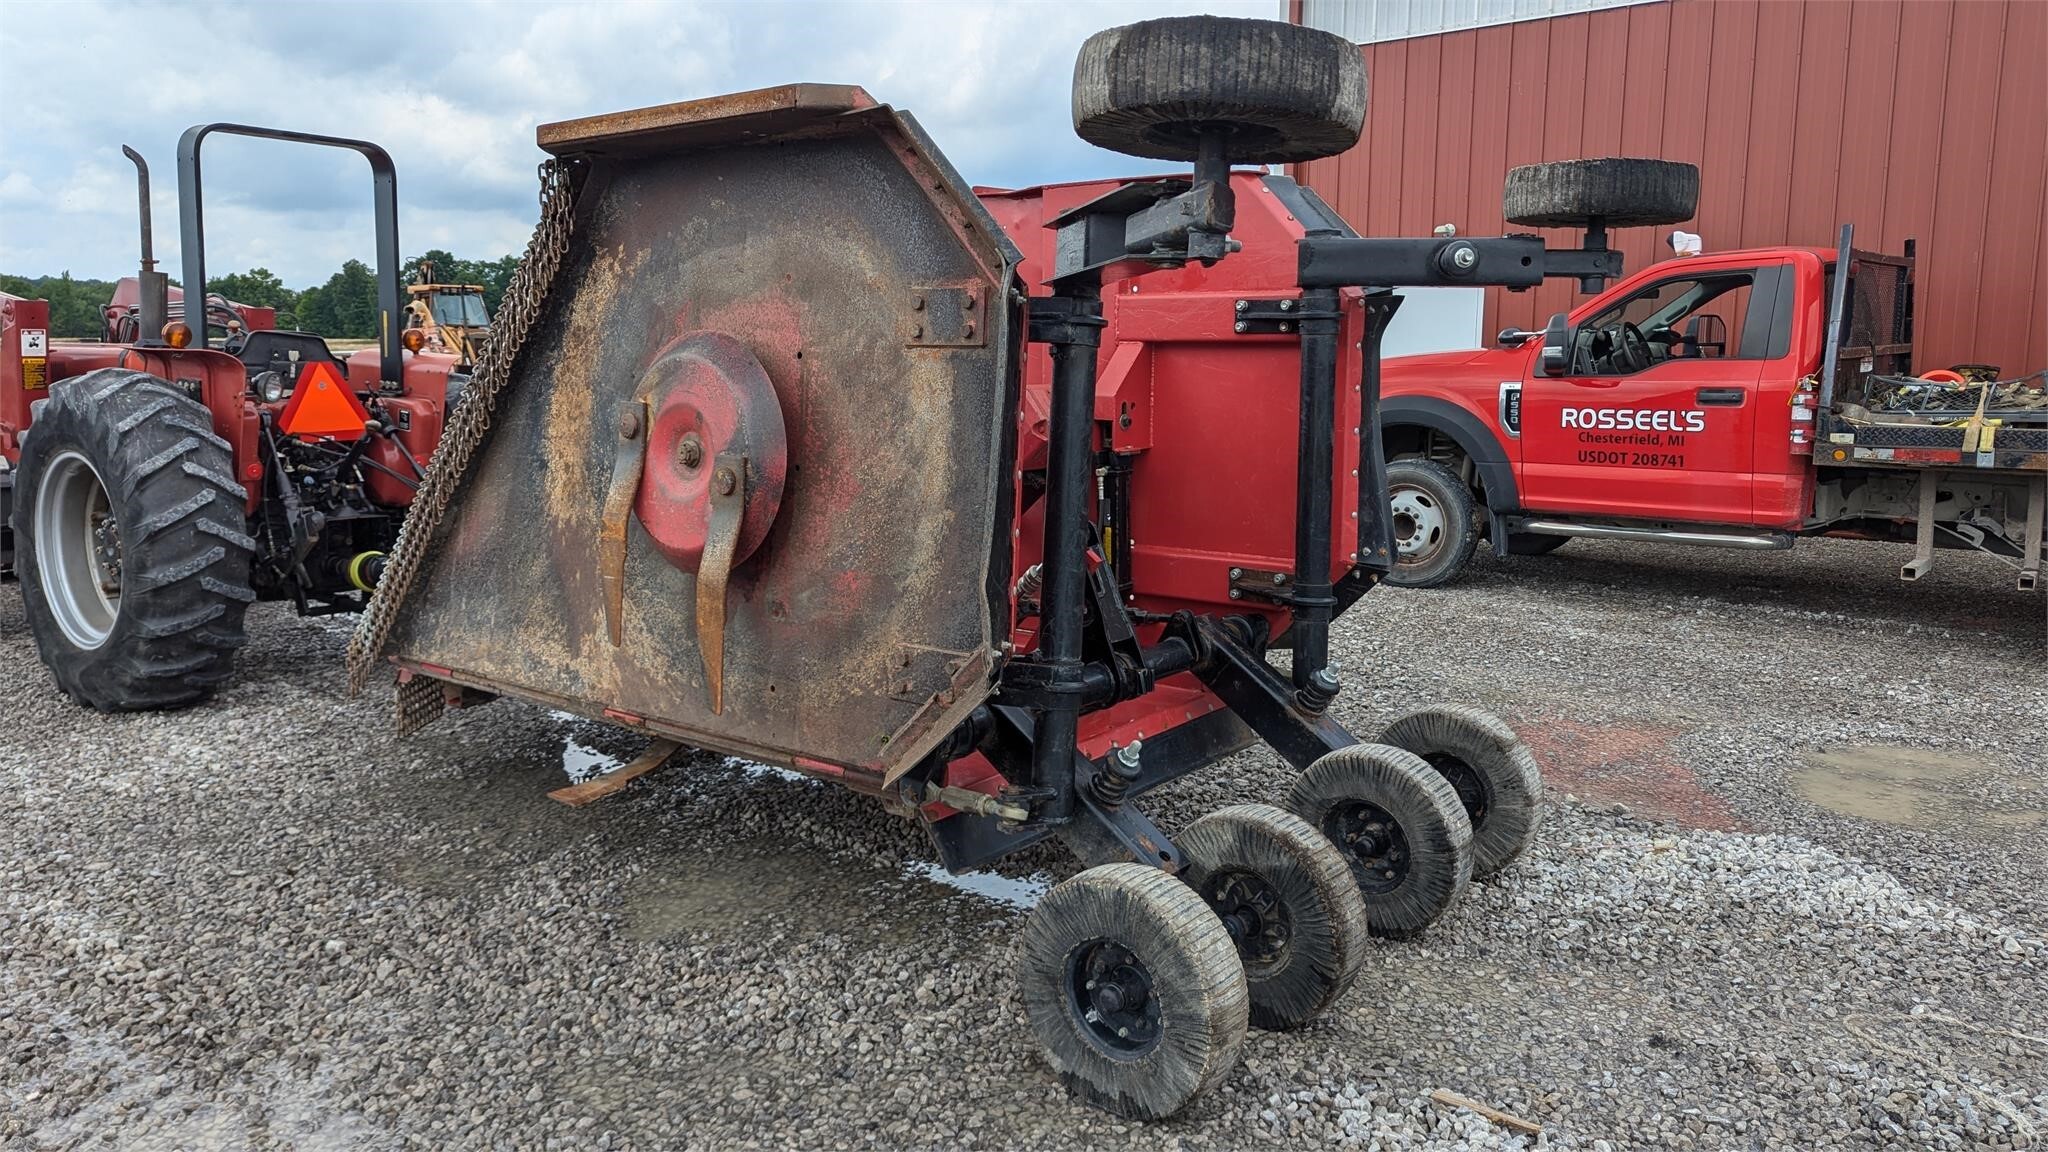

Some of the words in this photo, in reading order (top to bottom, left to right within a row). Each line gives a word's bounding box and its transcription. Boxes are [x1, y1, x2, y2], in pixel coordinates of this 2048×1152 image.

[1510, 393, 1520, 424] F550
[1561, 408, 1705, 432] ROSSEEL'S
[1578, 431, 1664, 447] Chesterfield,
[1667, 435, 1685, 446] MI
[1578, 450, 1628, 464] USDOT
[1632, 453, 1684, 467] 208741
